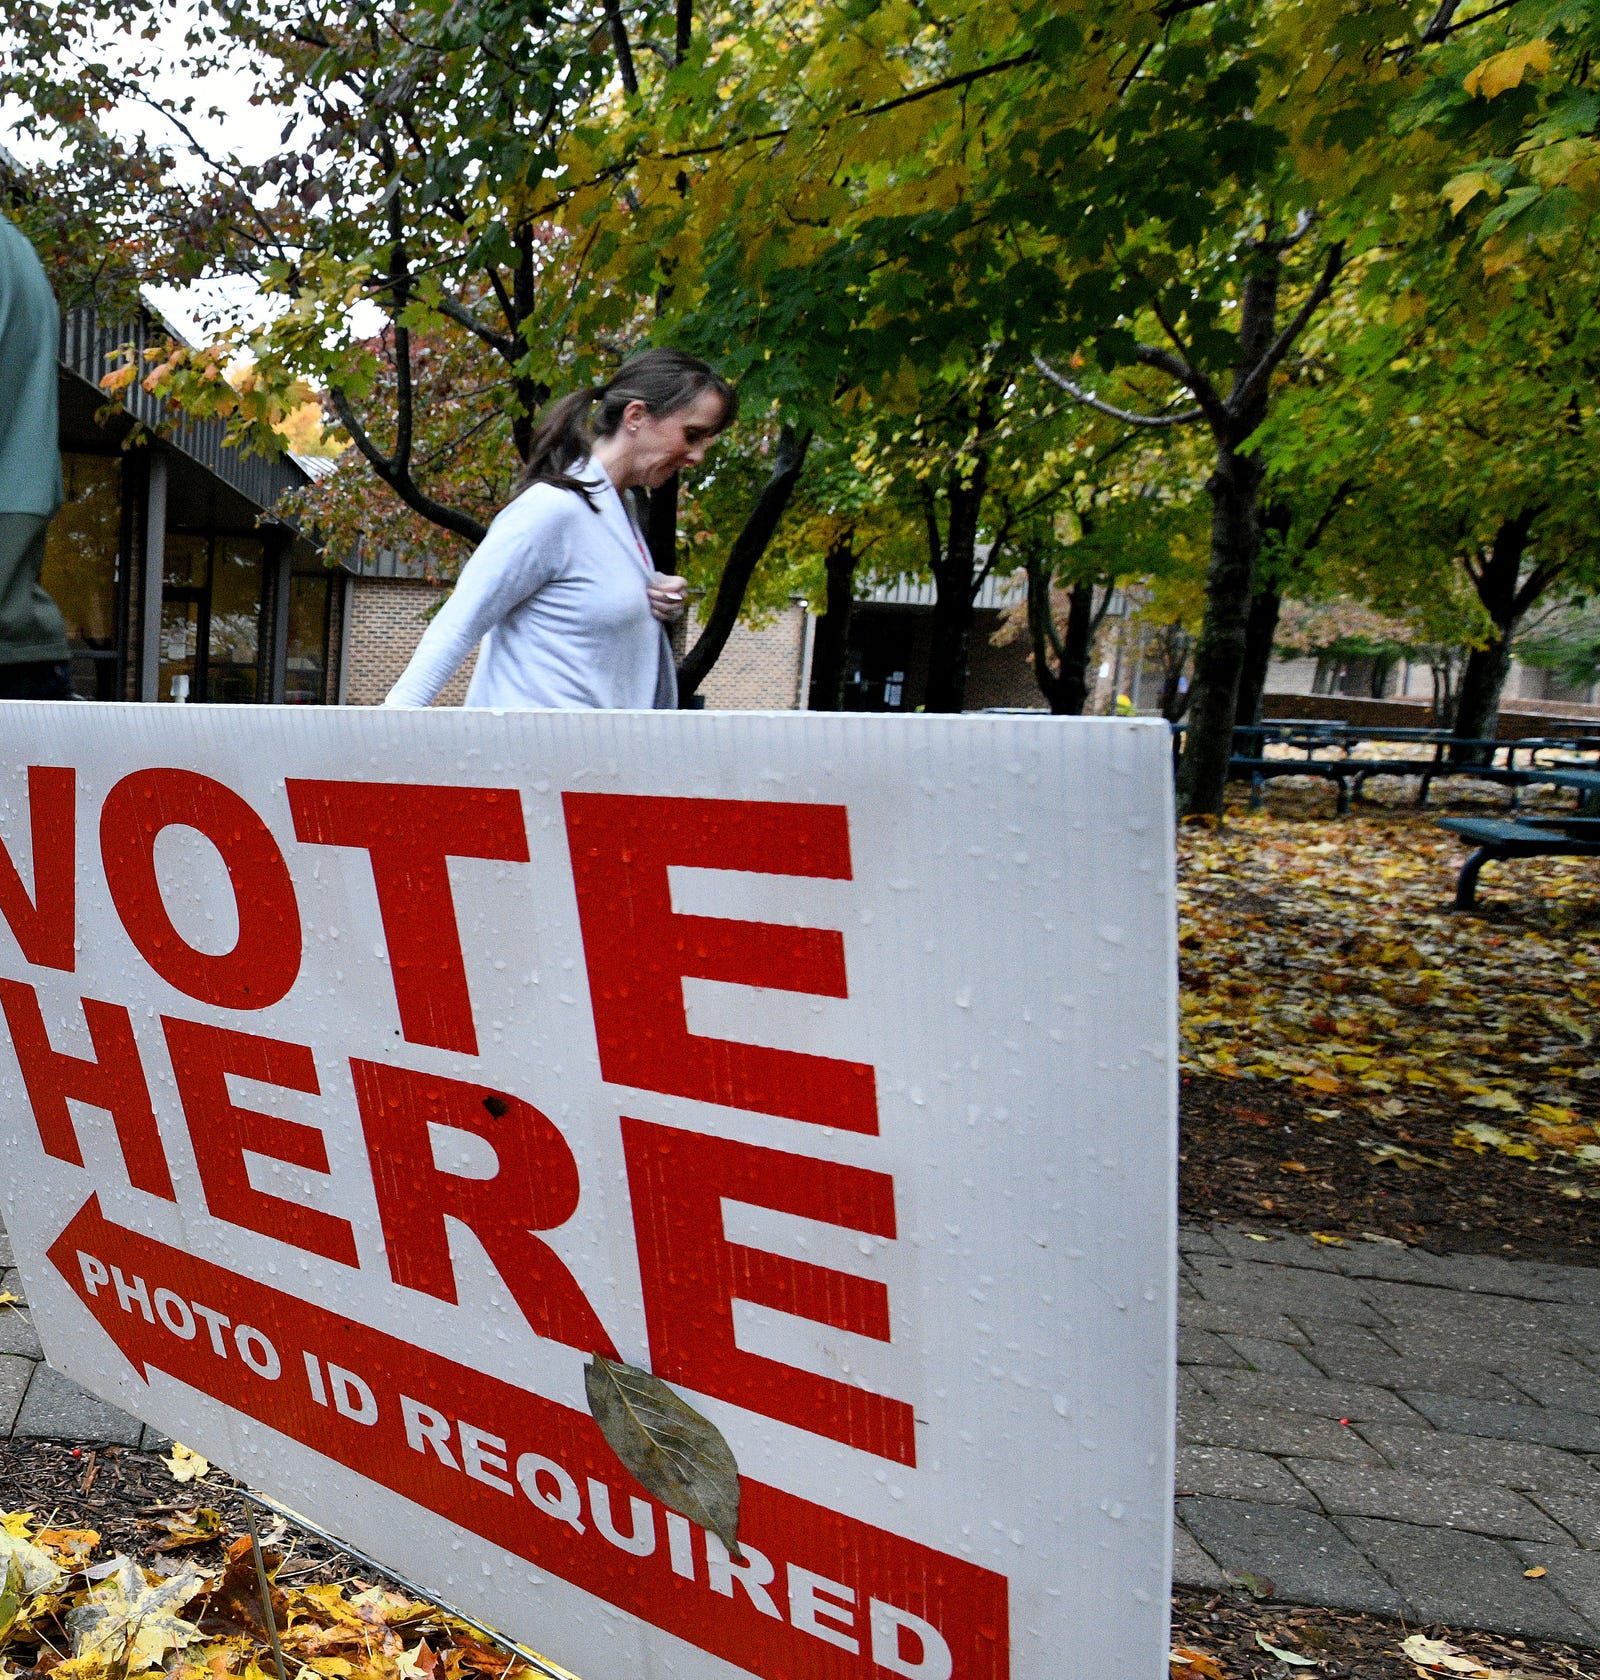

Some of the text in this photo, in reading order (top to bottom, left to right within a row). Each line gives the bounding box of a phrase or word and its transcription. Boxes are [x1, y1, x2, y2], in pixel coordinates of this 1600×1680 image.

[75, 1250, 954, 1680] PHOTO ID REQUIRED
